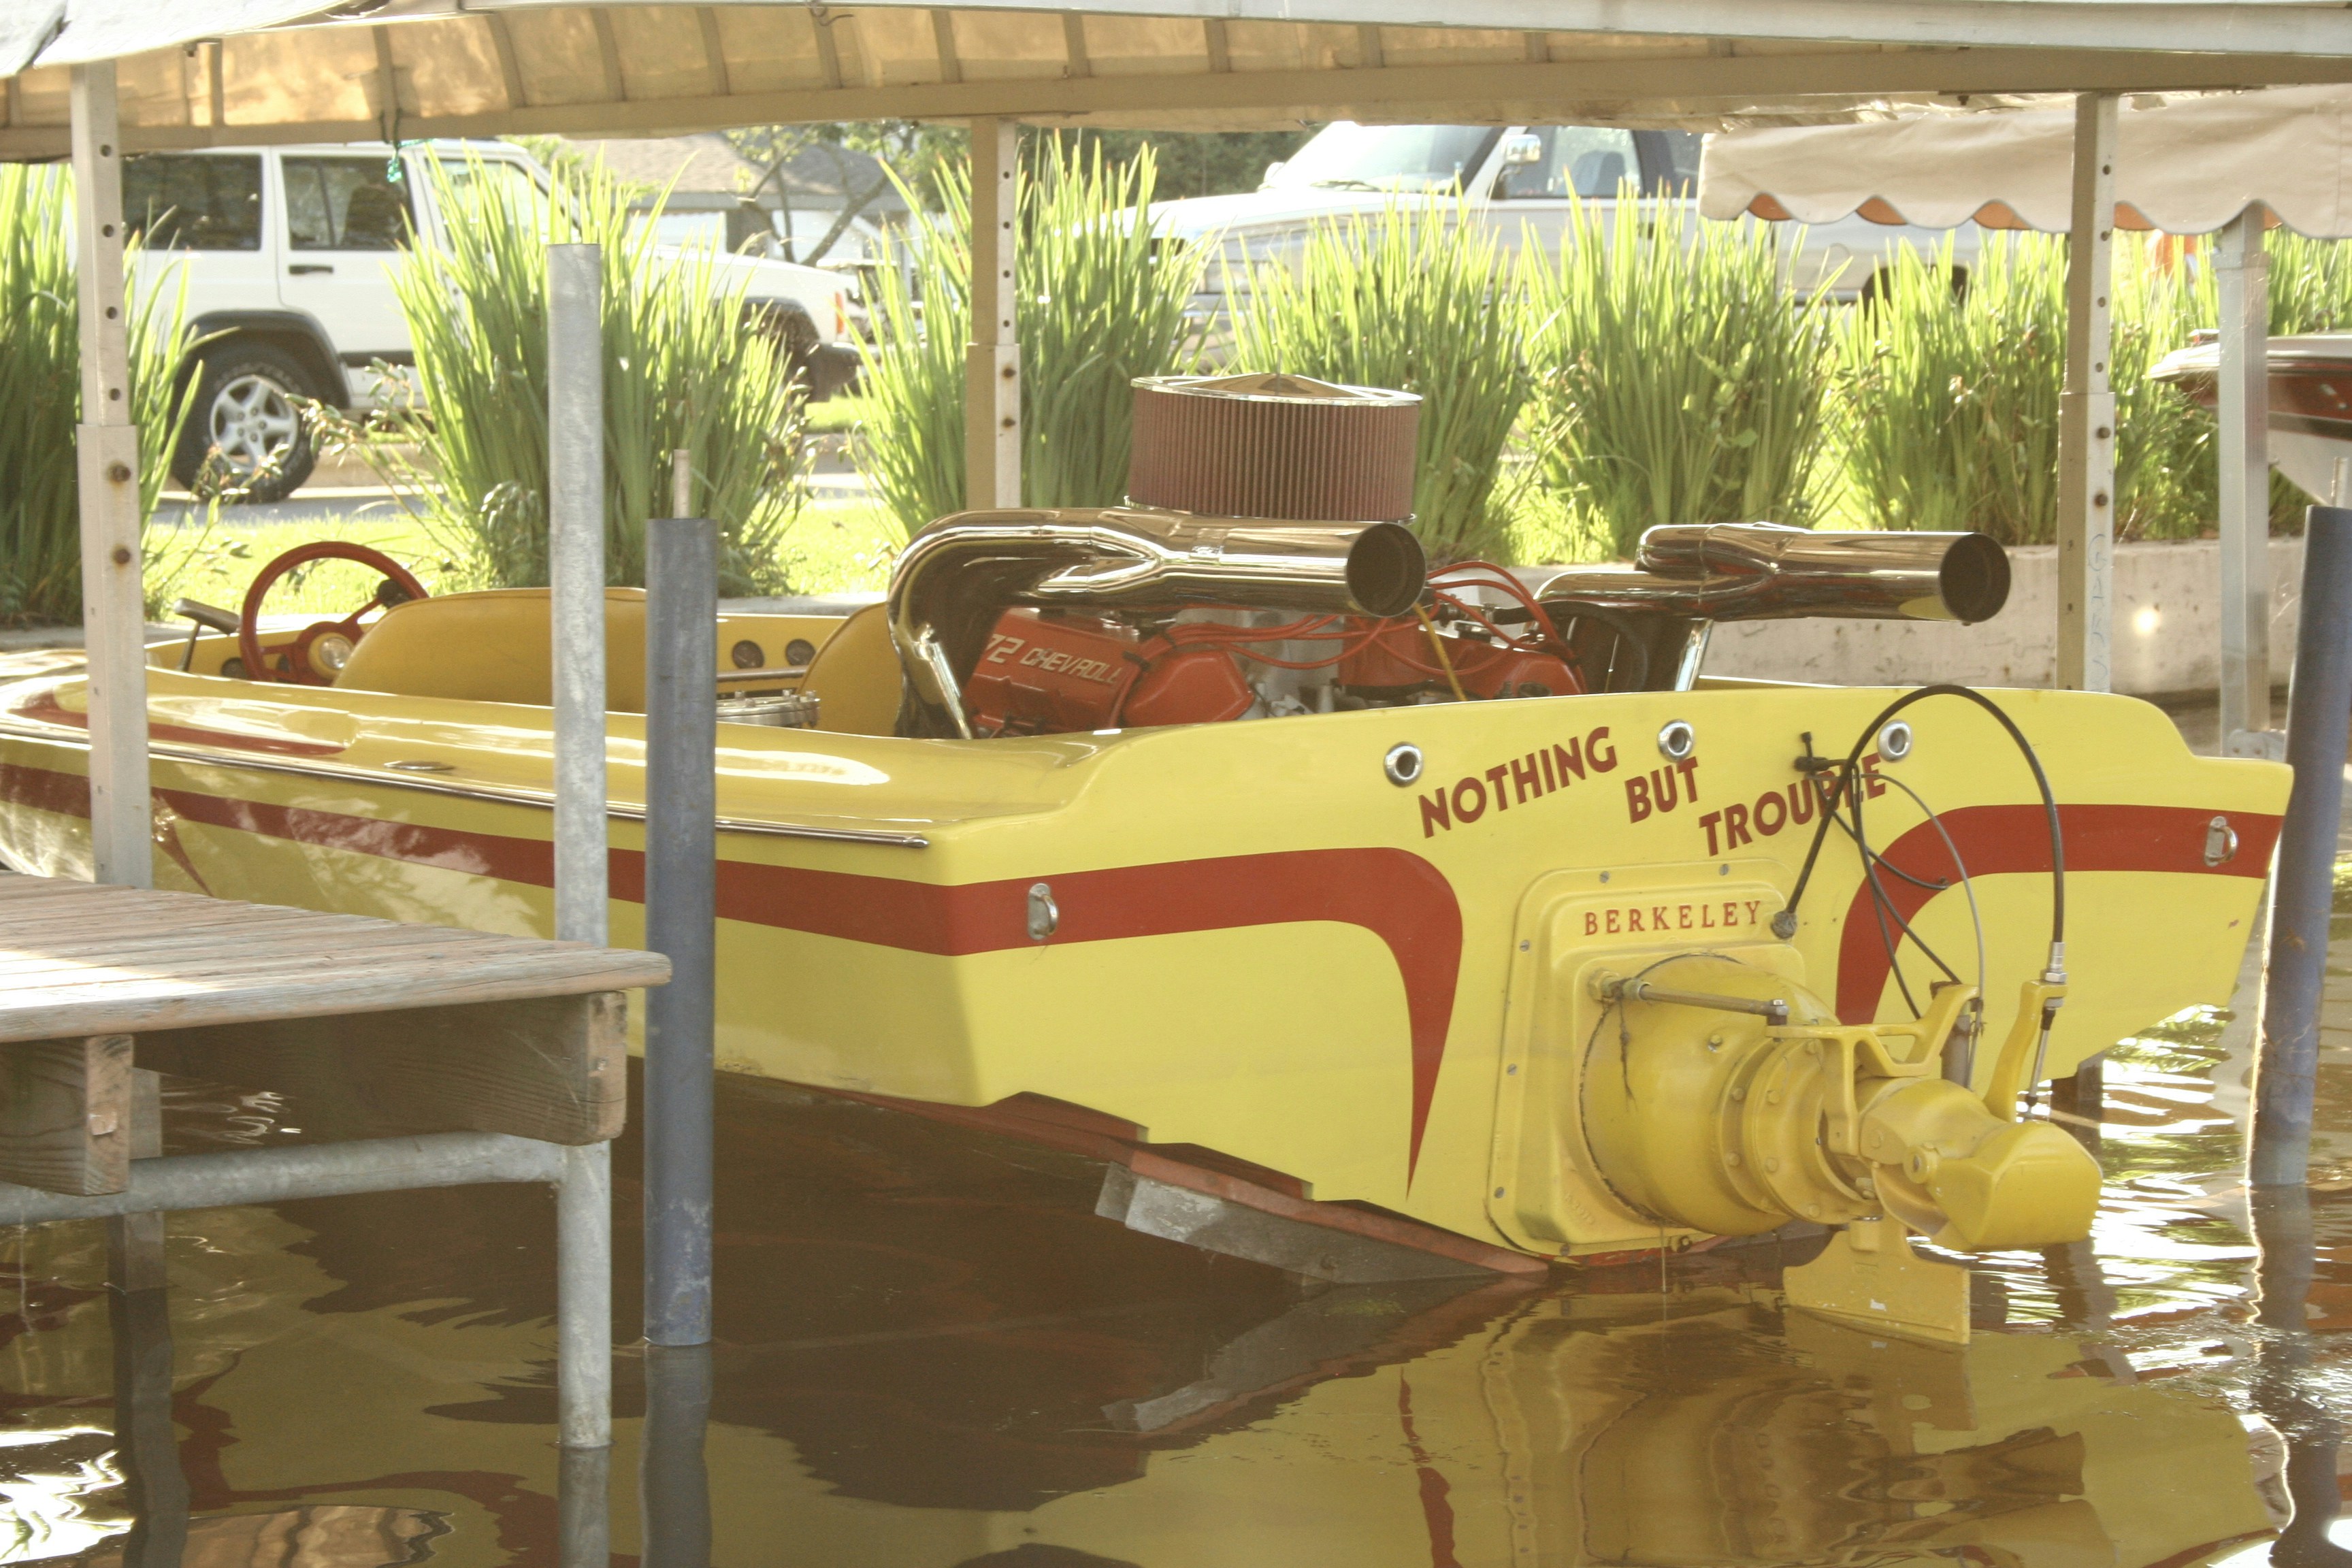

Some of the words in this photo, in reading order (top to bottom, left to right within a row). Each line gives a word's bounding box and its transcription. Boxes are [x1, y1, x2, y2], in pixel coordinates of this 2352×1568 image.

[1418, 726, 1618, 838] NOTHING
[1624, 756, 1698, 823] BUT
[1584, 901, 1761, 936] BERKELEY
